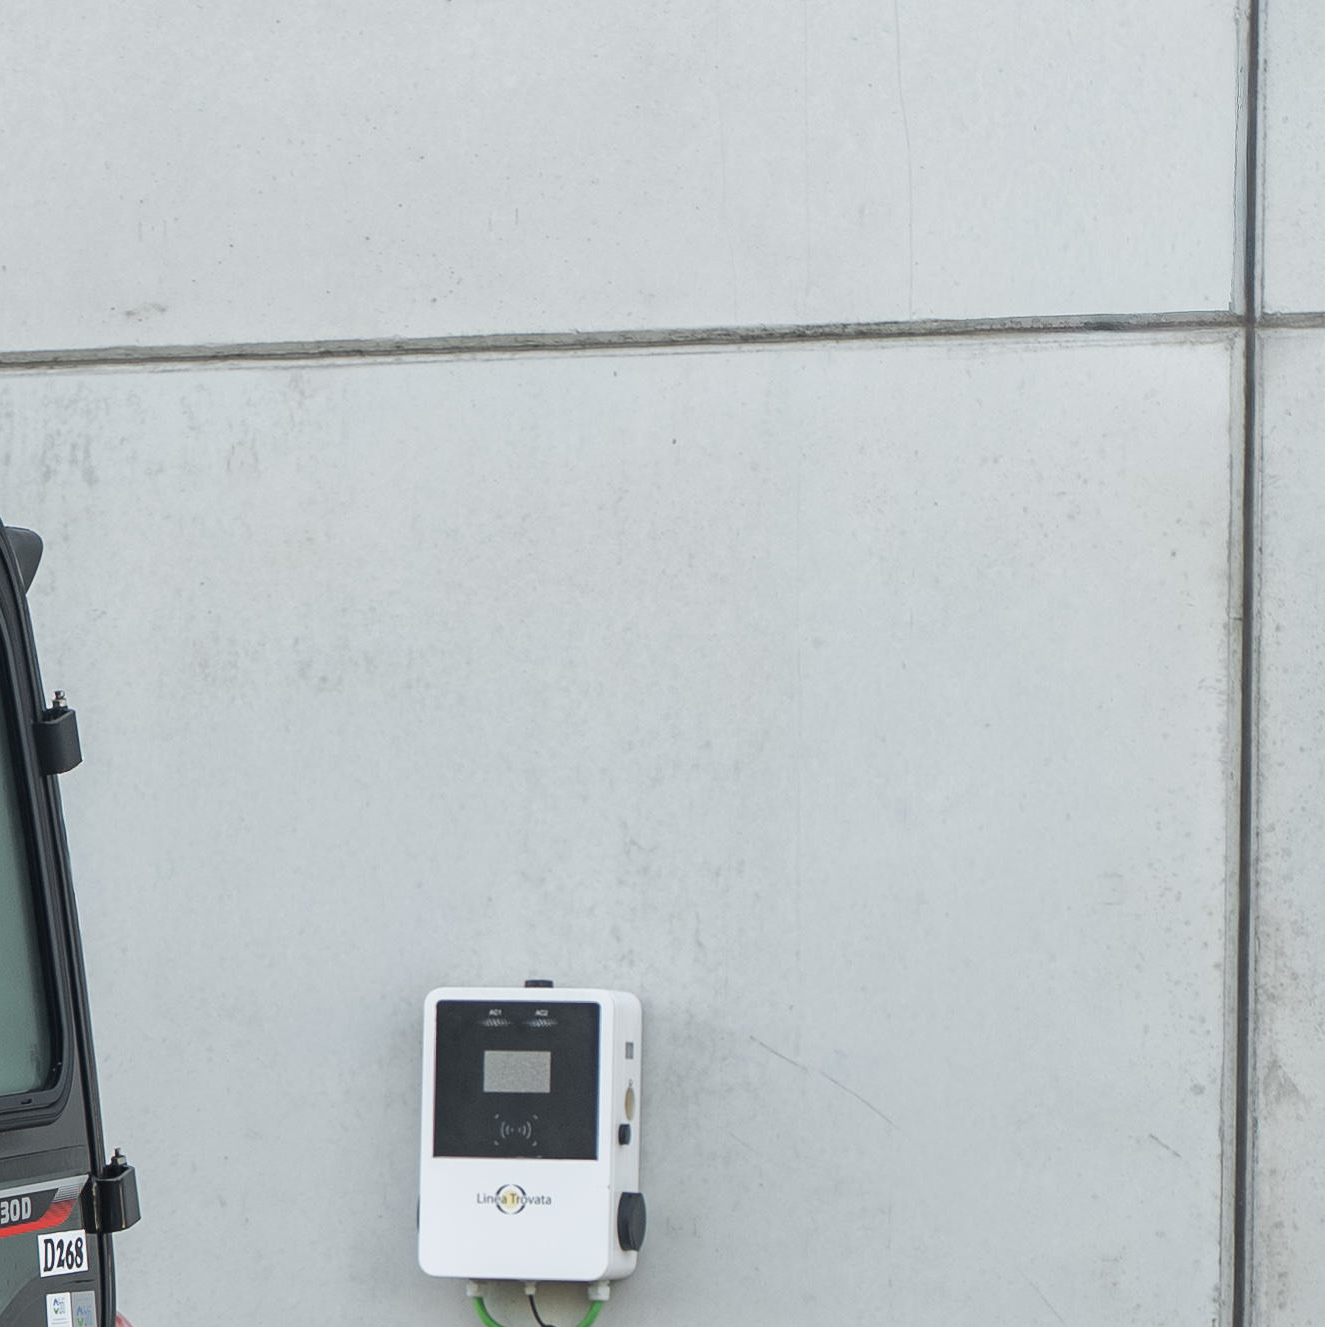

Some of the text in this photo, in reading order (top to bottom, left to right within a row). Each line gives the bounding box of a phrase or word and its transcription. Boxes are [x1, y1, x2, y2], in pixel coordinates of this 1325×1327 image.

[477, 1193, 552, 1205] Linea Trovata
[43, 1237, 83, 1272] D268
